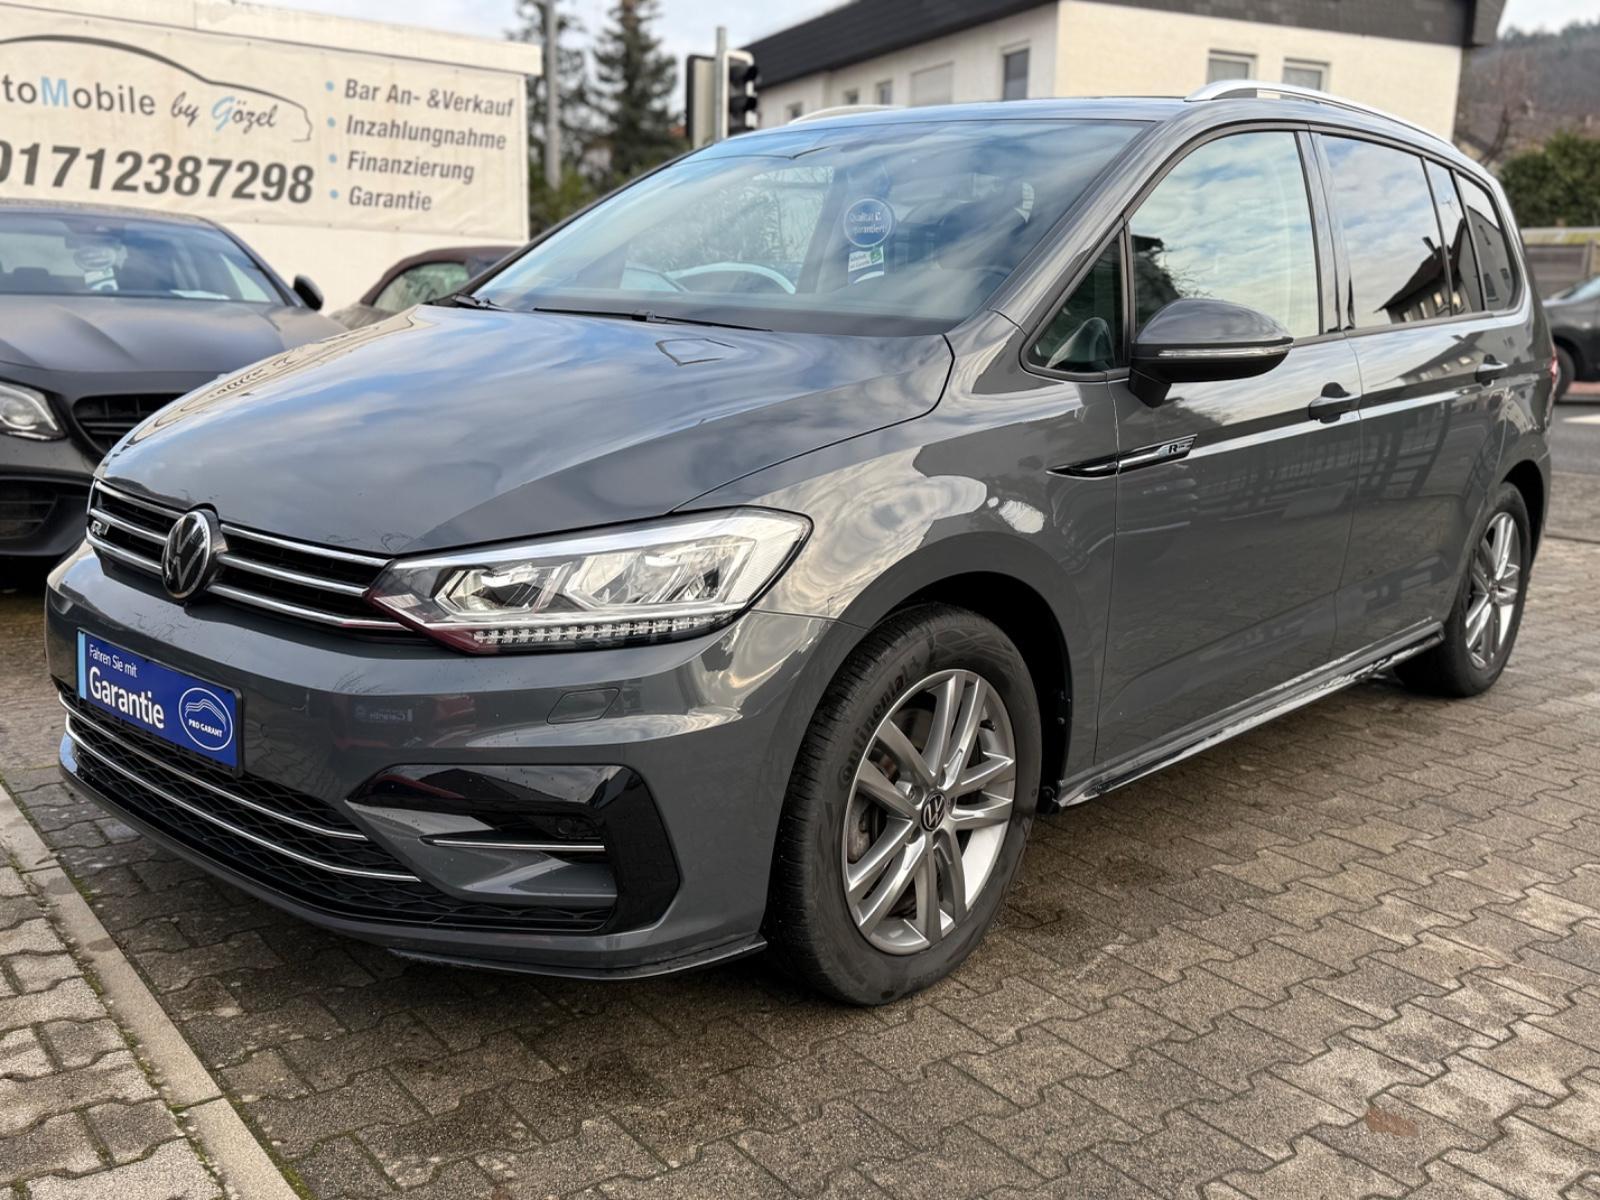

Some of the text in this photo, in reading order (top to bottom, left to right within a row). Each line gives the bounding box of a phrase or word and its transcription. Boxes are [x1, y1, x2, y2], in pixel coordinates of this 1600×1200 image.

[170, 91, 199, 127] by
[211, 95, 278, 134] Gözel
[344, 78, 514, 117] Bar An- &Verkauf
[346, 115, 507, 151] Inzahlungnahme
[347, 150, 475, 186] Finanzierung
[349, 185, 432, 211] Garantie
[89, 643, 138, 679] Fahren Sie mit
[89, 666, 165, 729] Garantie
[188, 718, 200, 730] PRO
